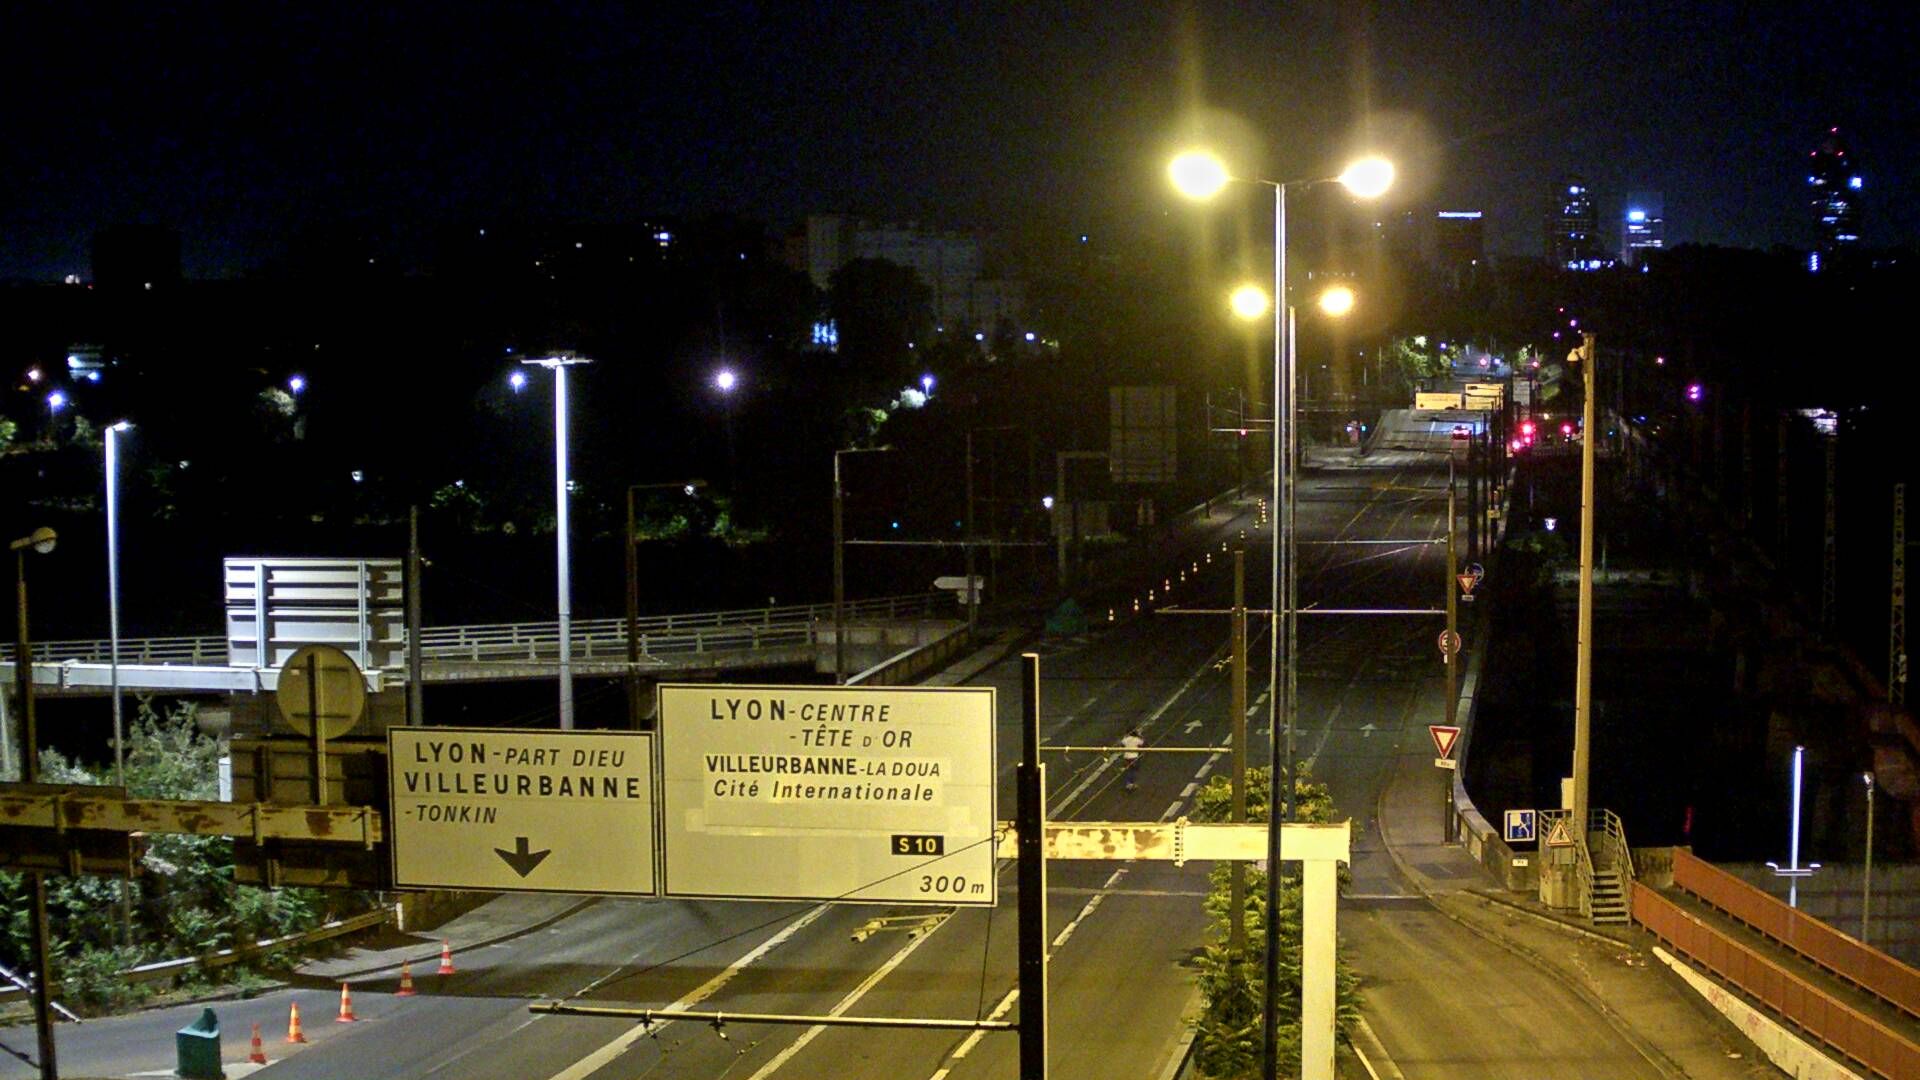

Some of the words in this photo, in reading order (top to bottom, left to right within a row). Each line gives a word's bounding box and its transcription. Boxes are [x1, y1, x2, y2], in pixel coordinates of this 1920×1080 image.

[711, 699, 890, 722] LYON-CENTRE
[415, 742, 560, 766] LYON-PART
[572, 750, 624, 767] DIEU
[706, 755, 886, 776] VILLEURBANNE-LA
[892, 762, 940, 777] DOUA
[404, 772, 640, 798] VILLEURBANNE
[713, 779, 759, 797] Cité
[772, 781, 934, 801] Internationale
